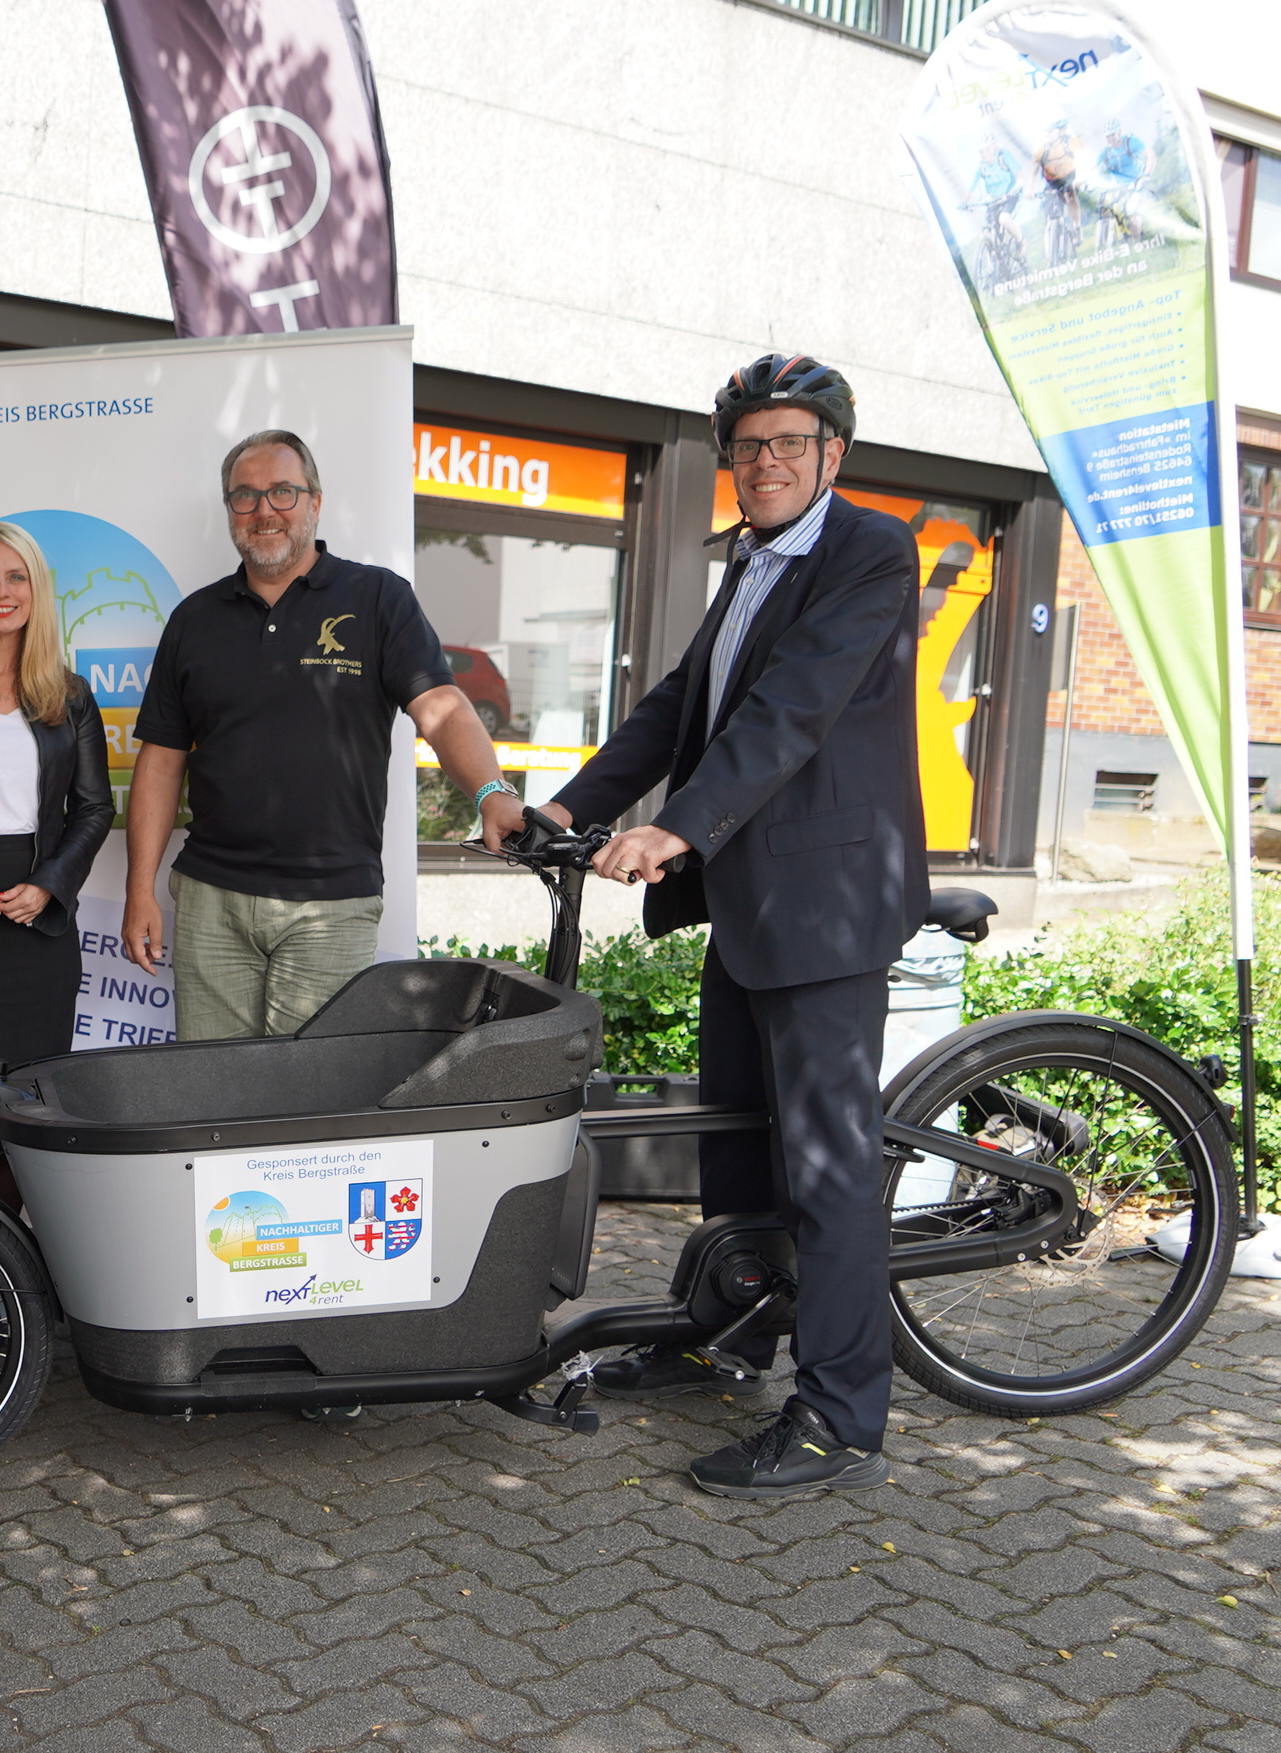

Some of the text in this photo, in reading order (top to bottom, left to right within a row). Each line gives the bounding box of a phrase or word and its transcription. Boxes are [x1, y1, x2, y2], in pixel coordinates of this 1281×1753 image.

[26, 397, 154, 422] BERGSTRASSE
[414, 431, 549, 507] kking
[1031, 603, 1049, 633] 9
[496, 745, 582, 772] Beratung
[100, 977, 175, 1008] INNO
[247, 1151, 381, 1171] Gesponsert durch den
[263, 1165, 365, 1182] Kreis Bergstraße
[260, 1222, 339, 1237] NACHHALTIGER
[256, 1242, 285, 1252] KREIS
[233, 1255, 304, 1269] BERGSTRASSE
[309, 1294, 344, 1305] 4rent
